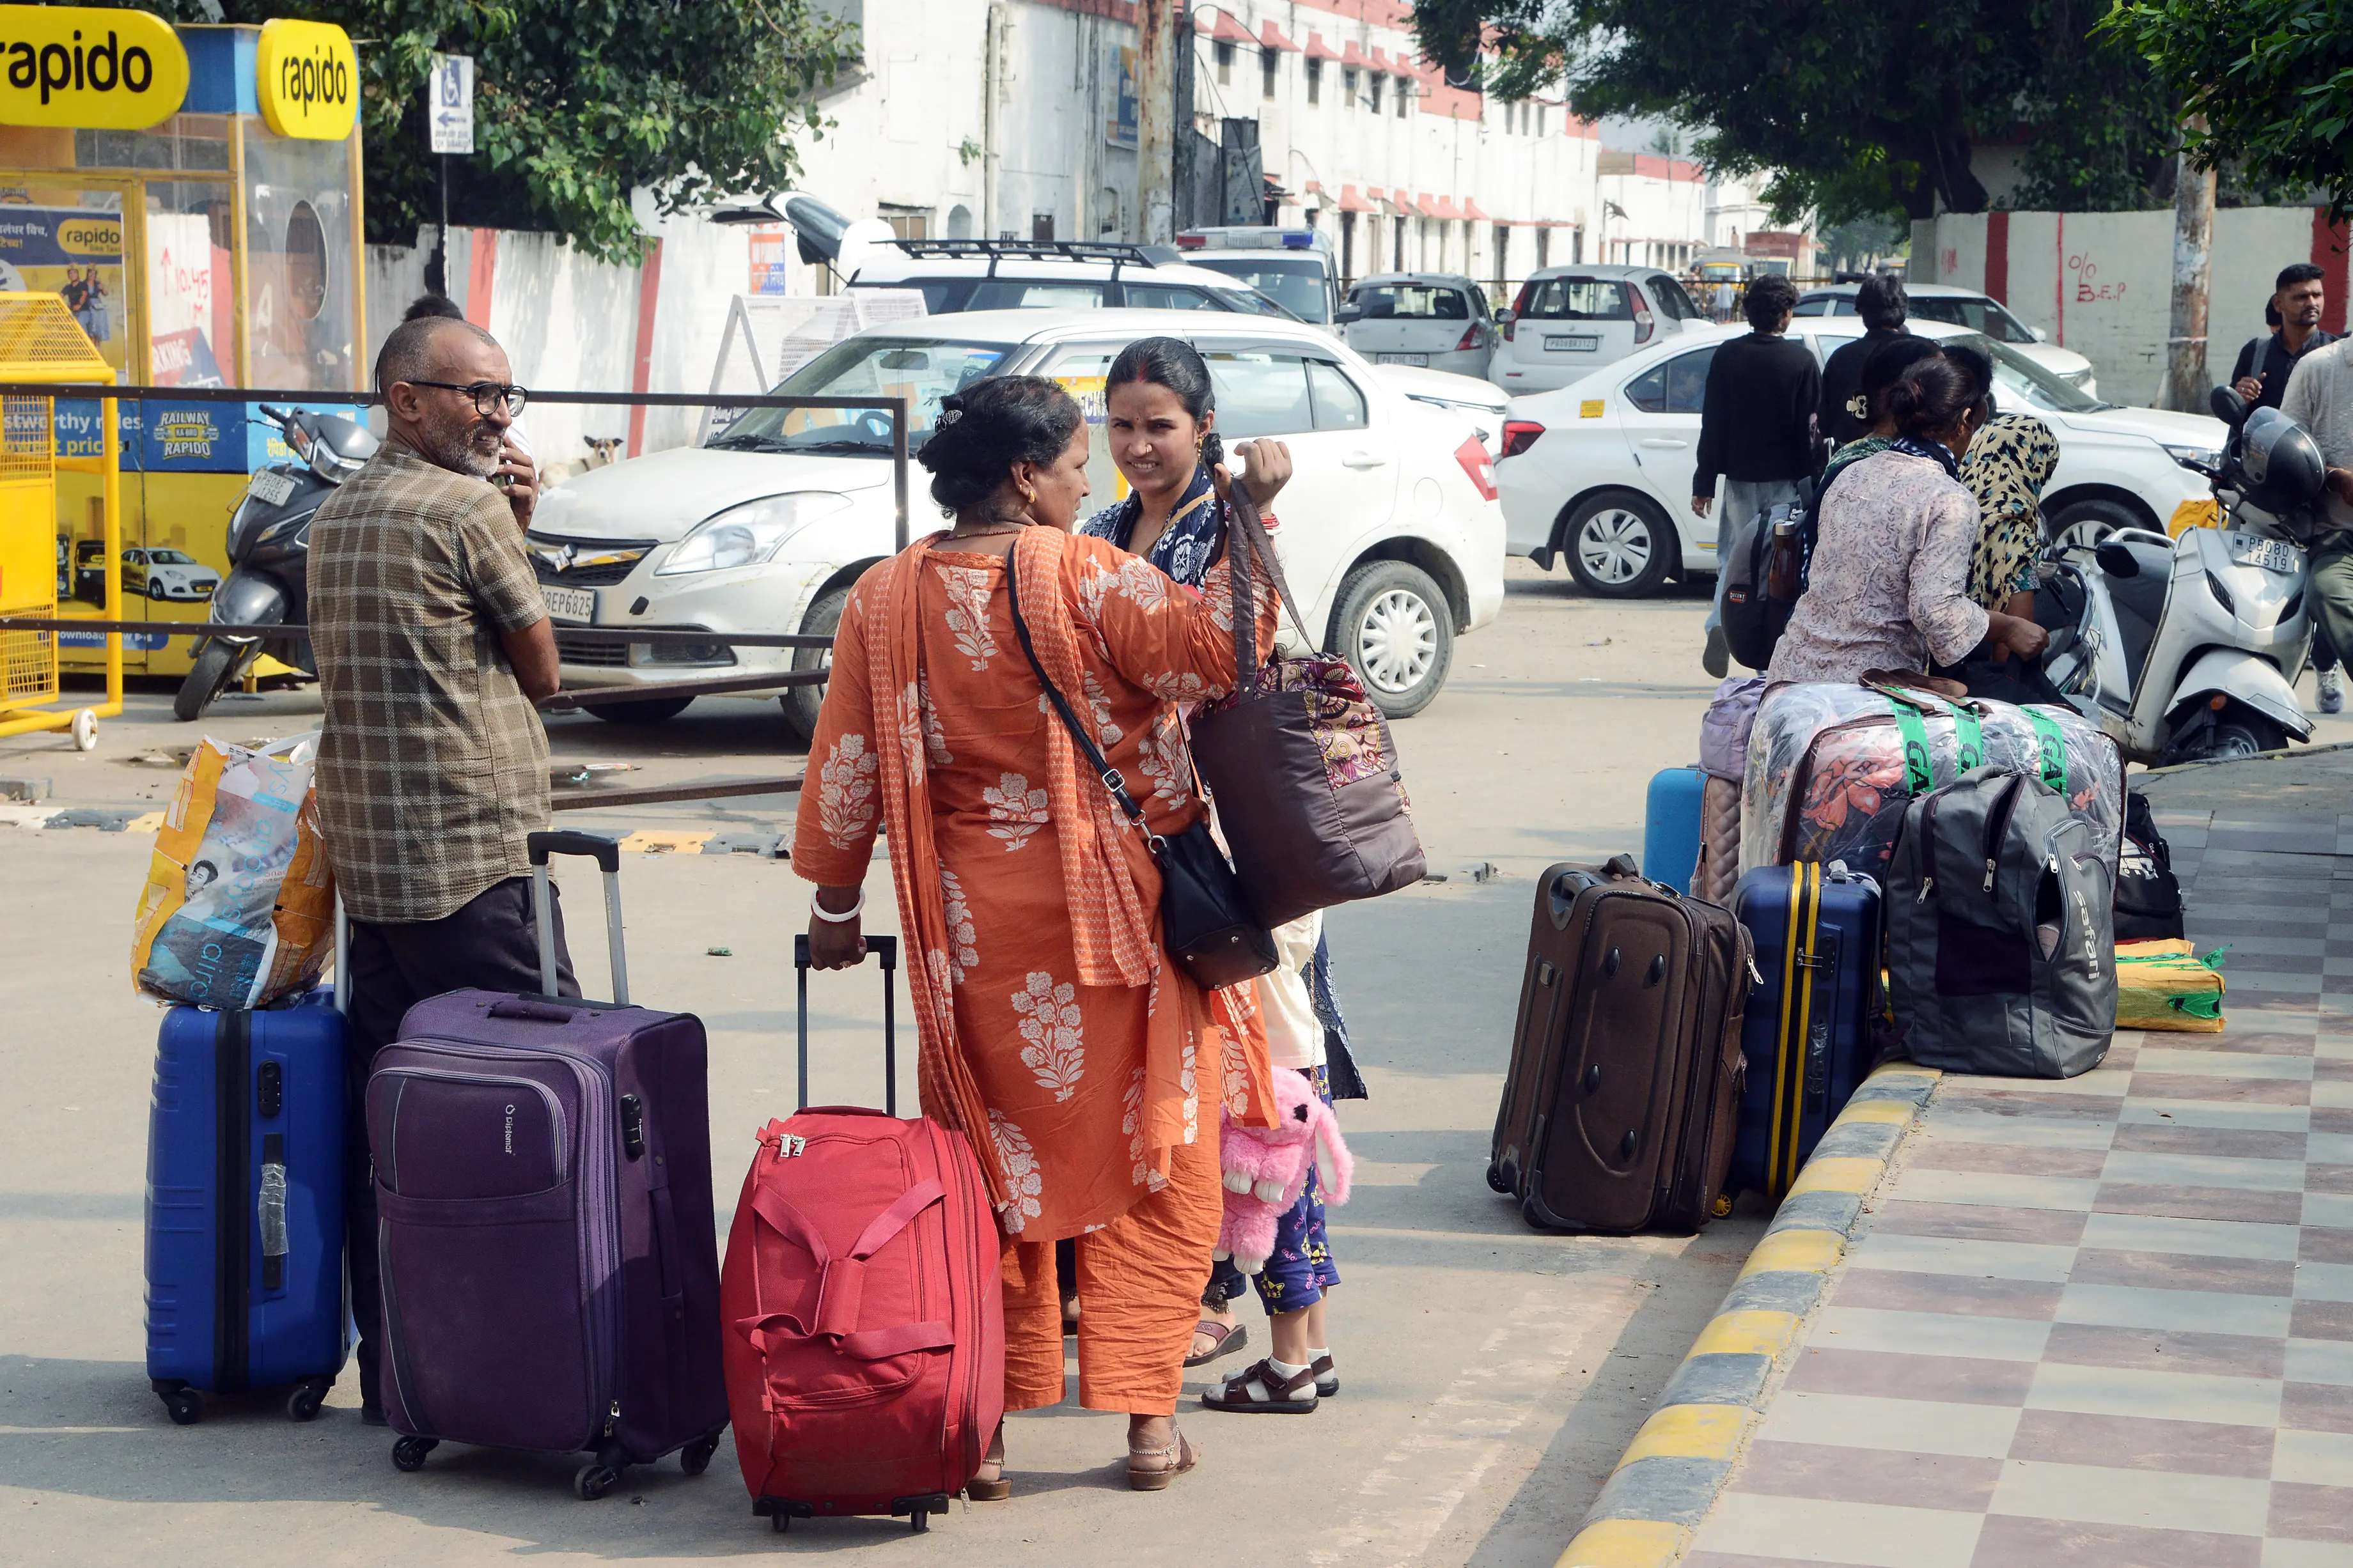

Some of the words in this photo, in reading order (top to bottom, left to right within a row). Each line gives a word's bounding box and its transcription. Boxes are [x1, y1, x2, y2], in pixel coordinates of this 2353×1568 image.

[282, 44, 347, 117] rapido
[66, 228, 120, 245] rapido
[160, 412, 209, 426] RAILWAY
[164, 442, 210, 456] RAPIDO
[2249, 538, 2289, 557] PB08D
[1730, 592, 1744, 601] DECENT
[2073, 890, 2100, 979] safari
